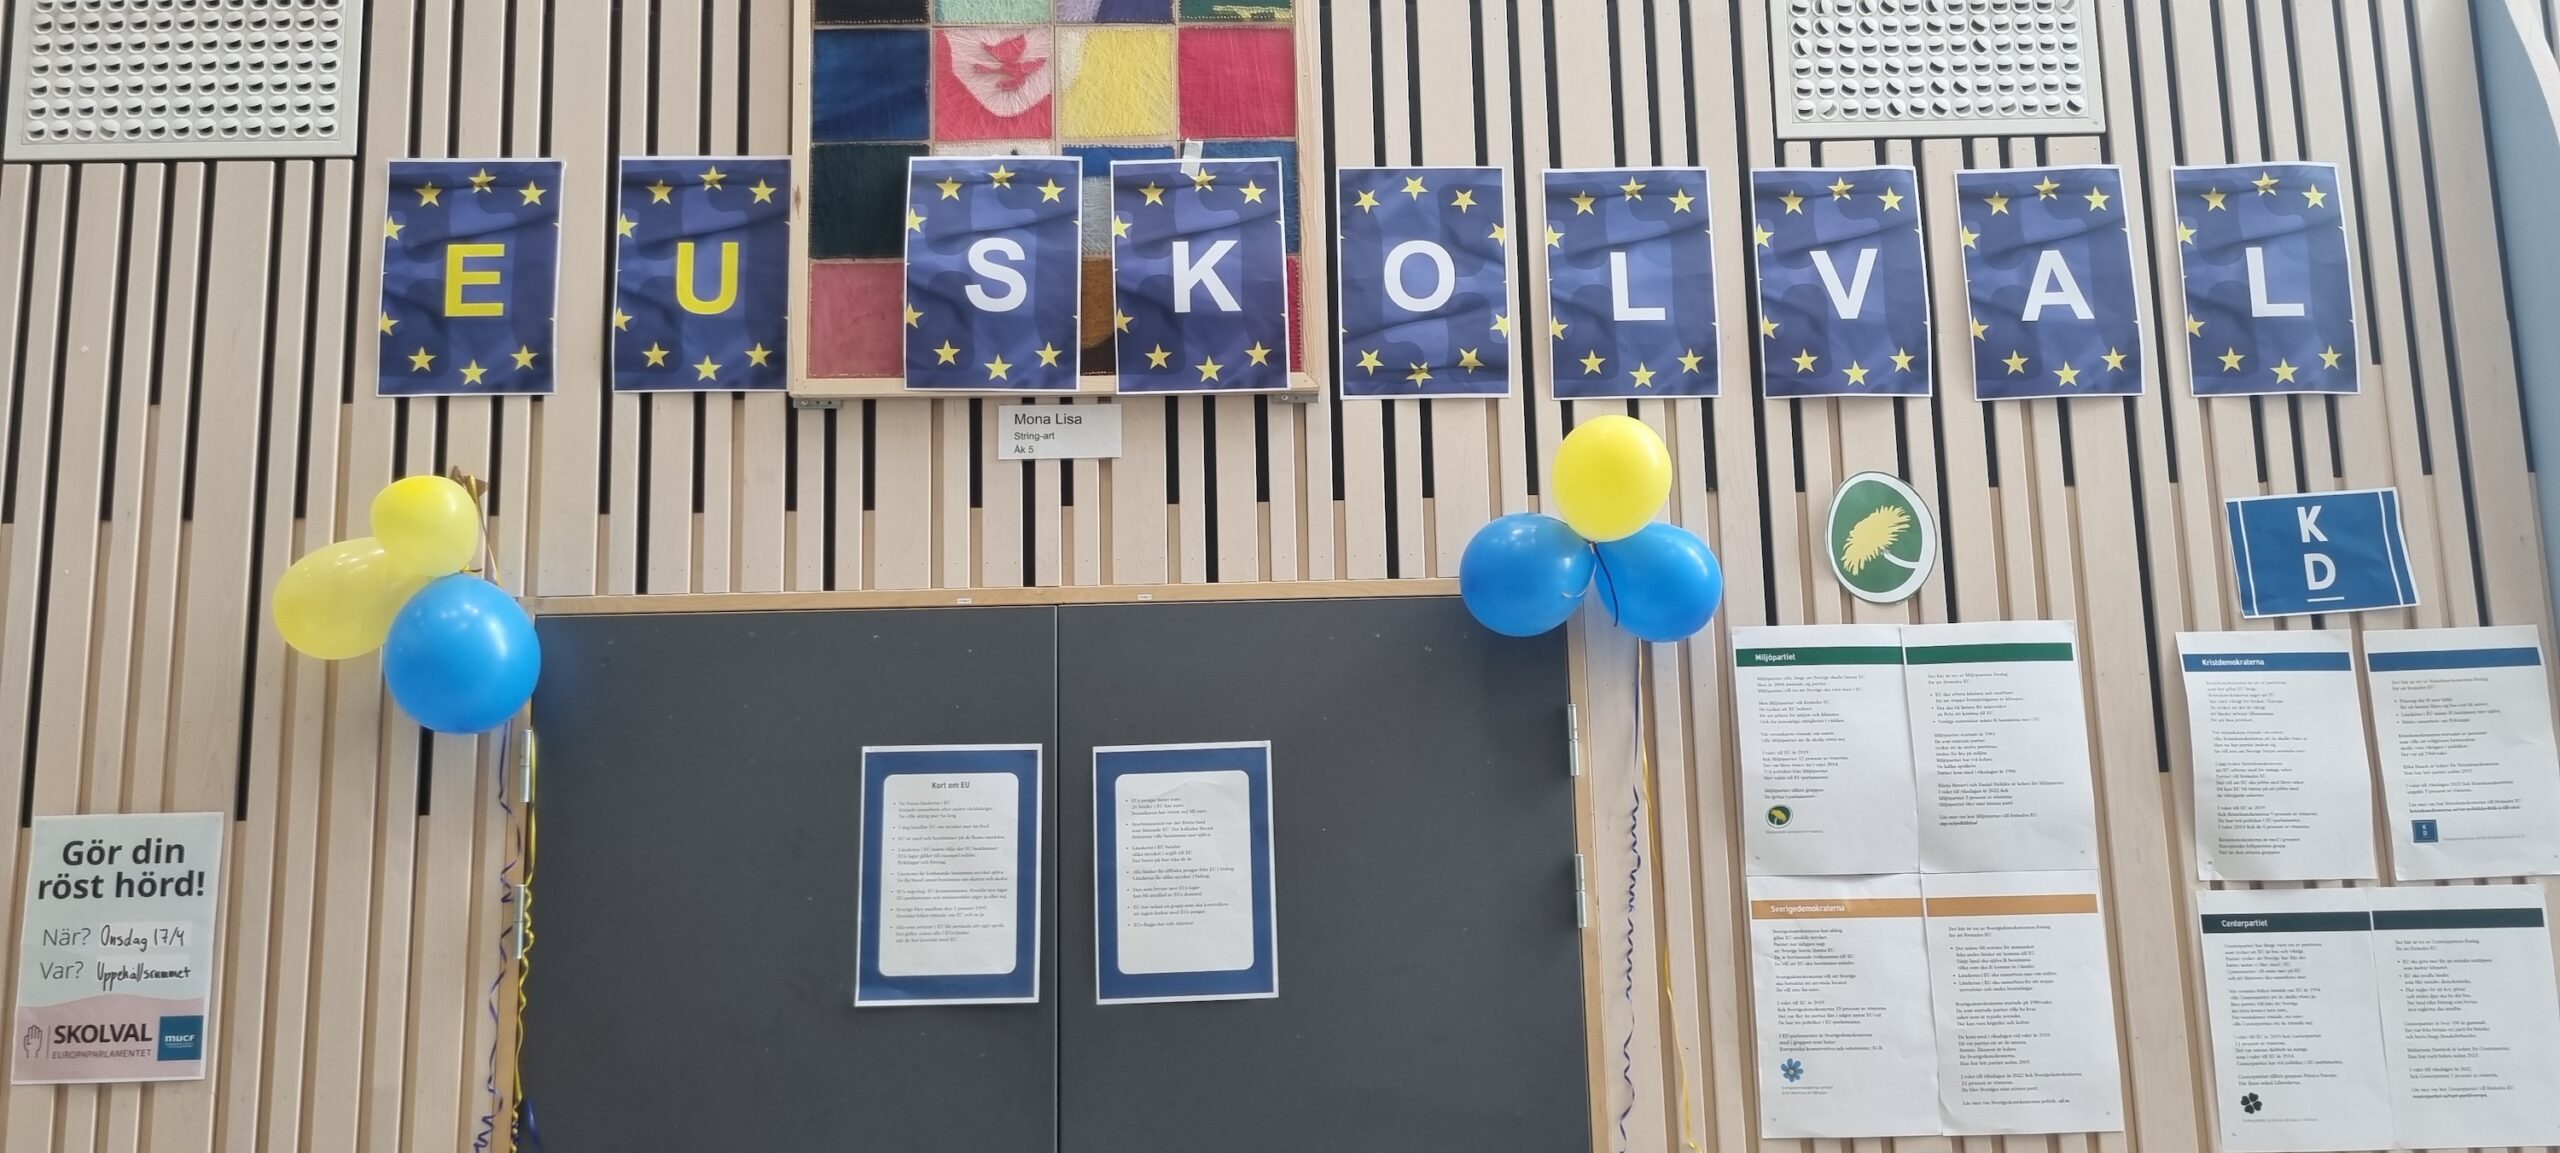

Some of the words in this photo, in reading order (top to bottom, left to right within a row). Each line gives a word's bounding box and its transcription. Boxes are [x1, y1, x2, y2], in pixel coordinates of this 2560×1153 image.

[1014, 413, 1051, 425] Mona
[1055, 413, 1083, 425] Lisa
[1014, 431, 1055, 441] String-art
[1014, 445, 1026, 454] Åk
[2296, 505, 2329, 543] K
[2303, 553, 2336, 590] D
[1755, 653, 1796, 663] Miljöpartiet
[2202, 658, 2265, 667] Kristdemokraterna
[960, 781, 970, 789] EU
[62, 839, 123, 866] Gör
[131, 837, 185, 864] din
[38, 872, 104, 899] röst
[115, 870, 206, 898] hörd!
[1770, 904, 1845, 915] Sverigedemokraterna
[2221, 919, 2268, 928] Centerpartiet
[43, 927, 91, 947] När?
[101, 924, 148, 952] Onsdag
[154, 926, 185, 946] 17/4
[40, 961, 84, 980] Var?
[53, 1023, 153, 1044] SKOLVAL
[52, 1048, 153, 1060] EUROPAPARLAMENTET
